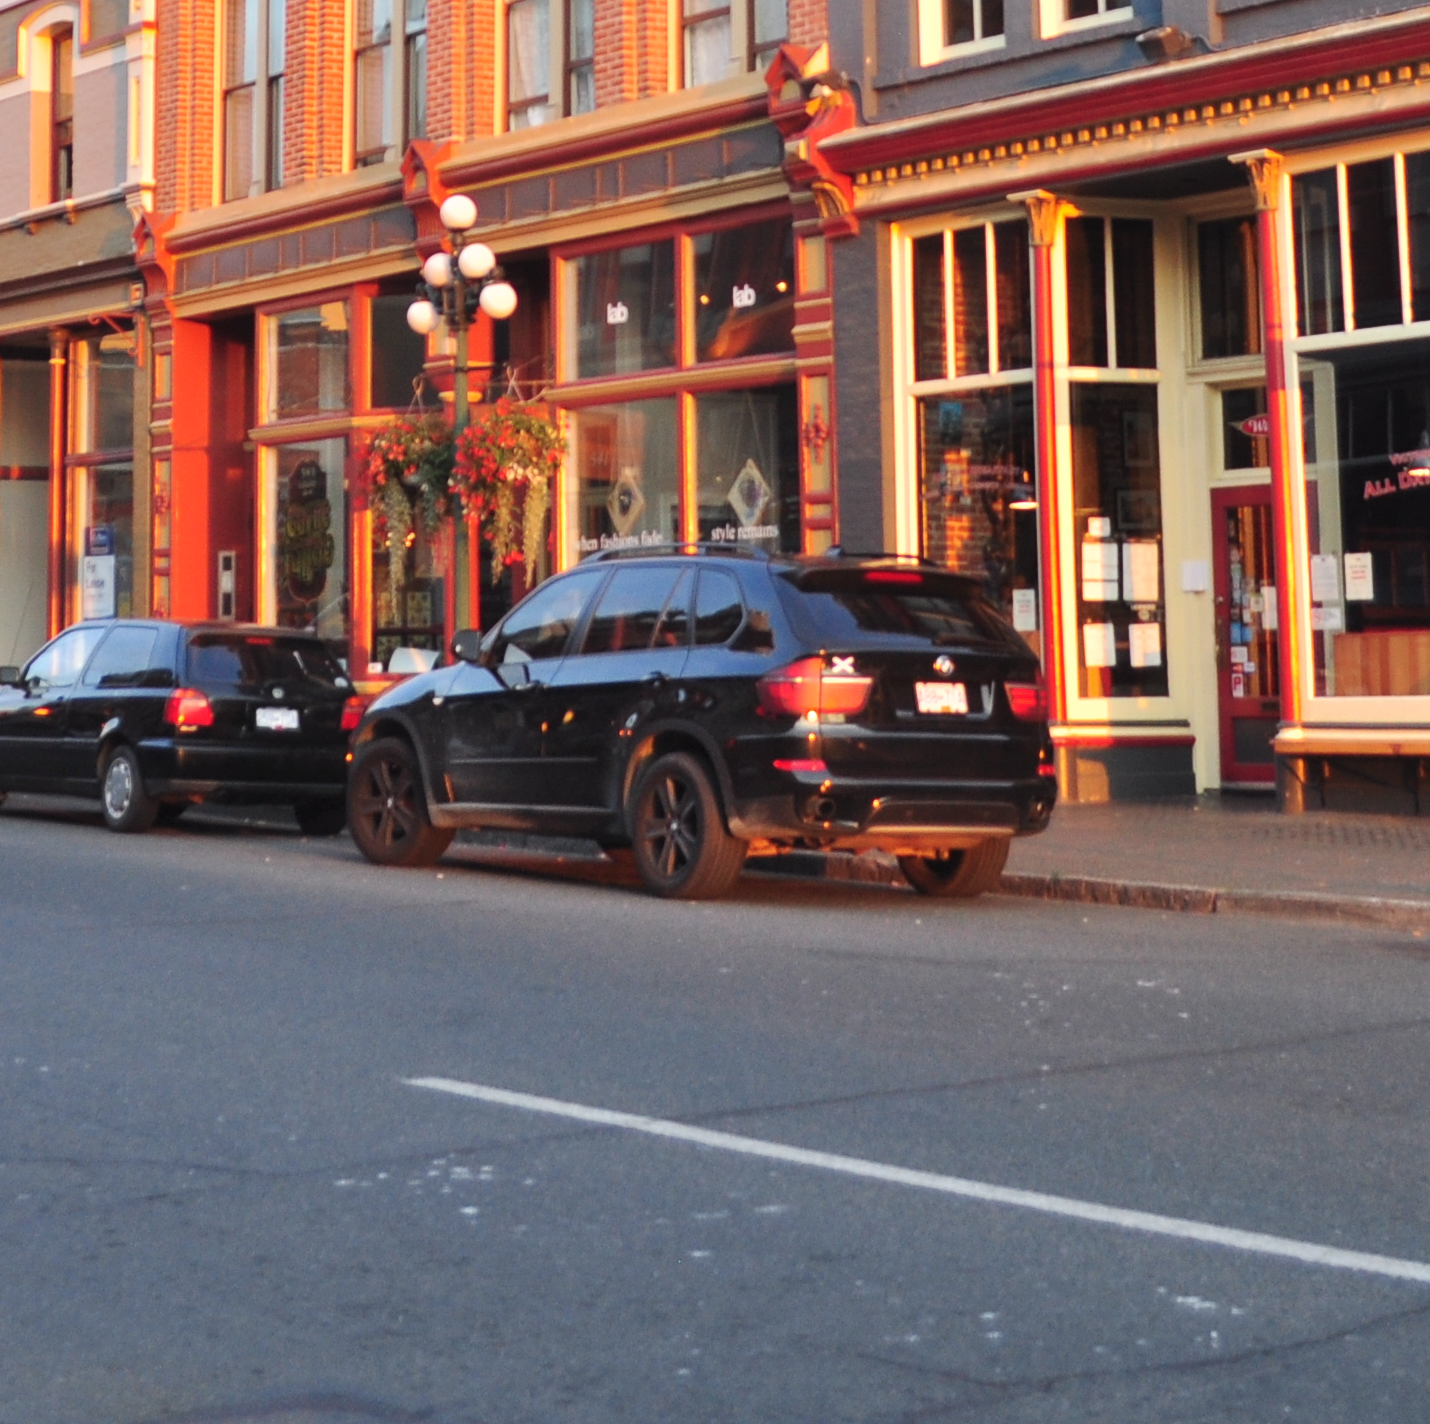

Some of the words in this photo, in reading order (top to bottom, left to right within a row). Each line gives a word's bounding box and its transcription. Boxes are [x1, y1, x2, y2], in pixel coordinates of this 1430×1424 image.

[732, 283, 756, 308] lab
[607, 301, 629, 324] lab
[1364, 478, 1396, 499] ALL
[599, 532, 639, 549] fashions
[640, 530, 664, 546] fade
[711, 525, 736, 542] style
[737, 524, 779, 539] remains
